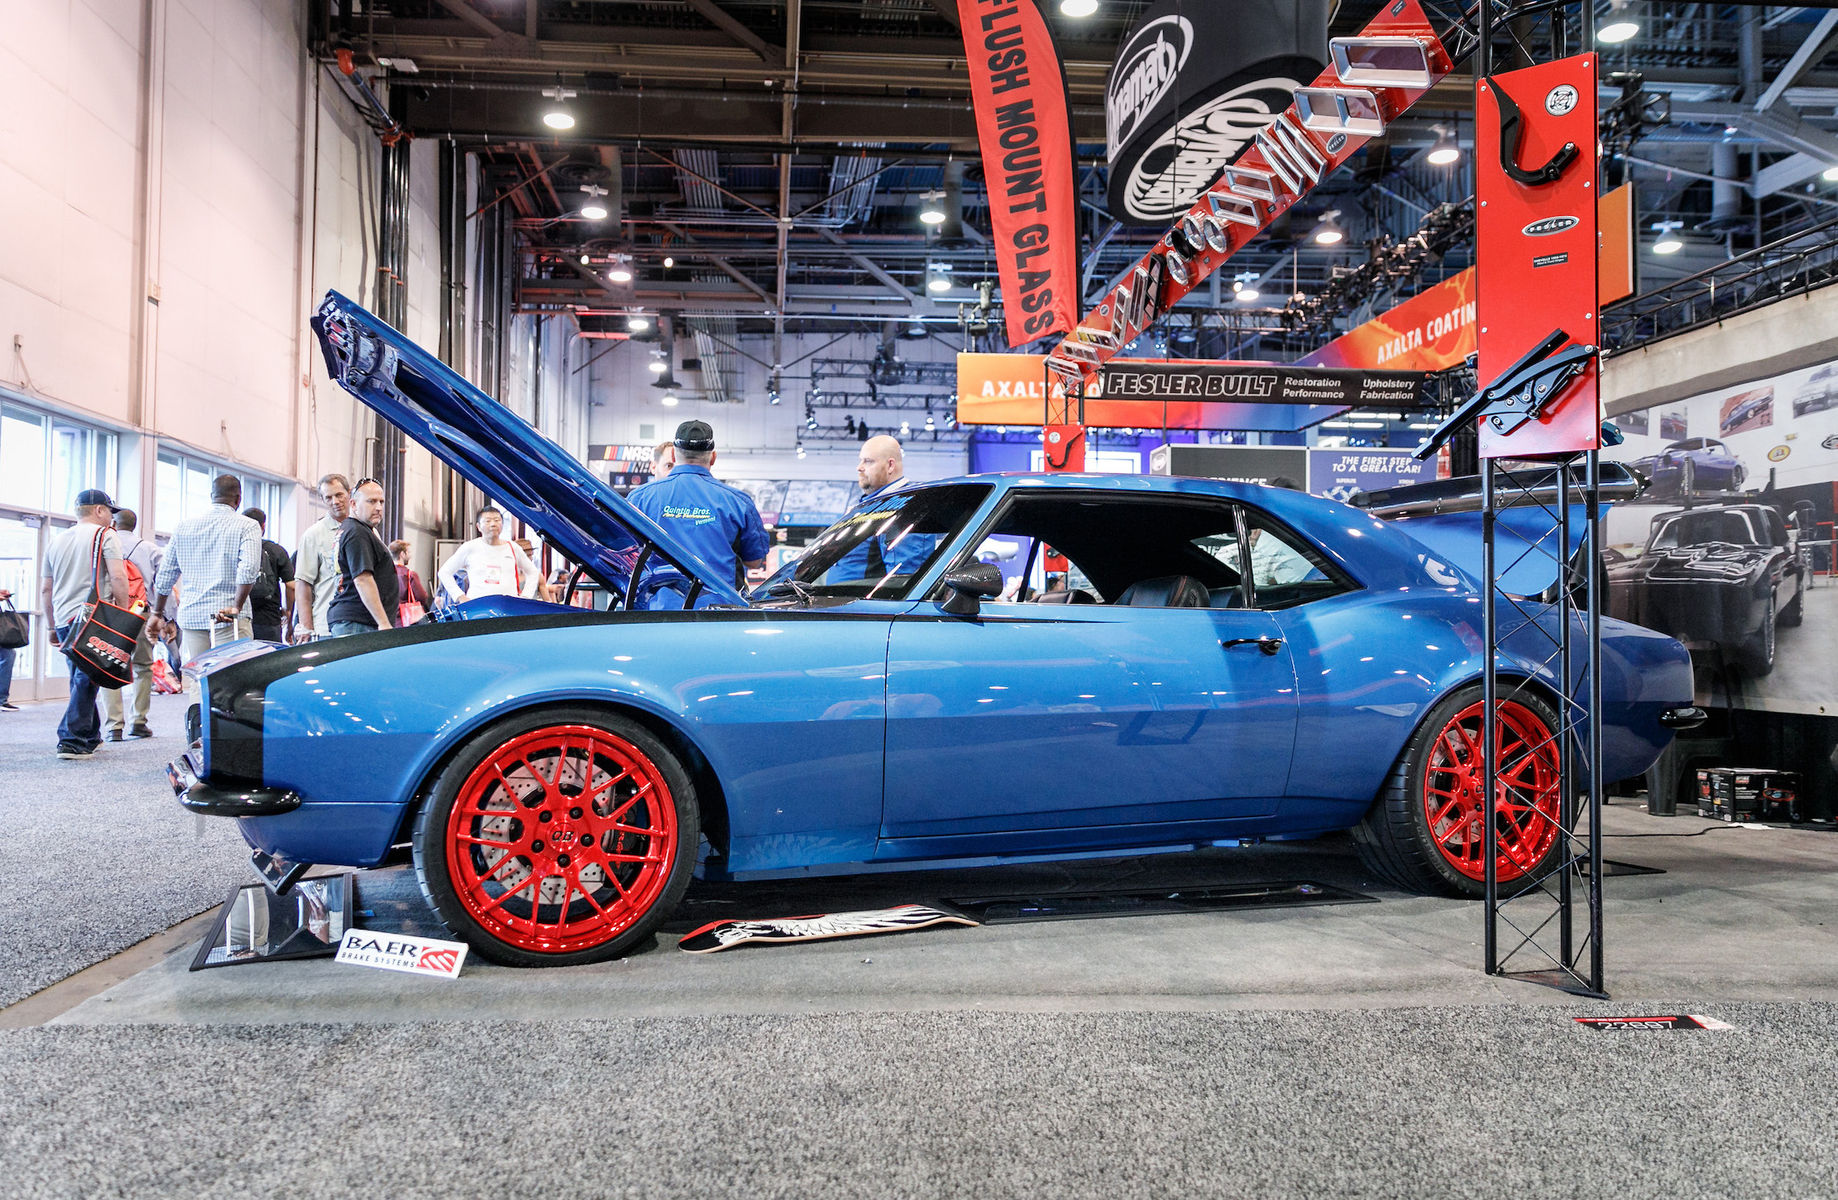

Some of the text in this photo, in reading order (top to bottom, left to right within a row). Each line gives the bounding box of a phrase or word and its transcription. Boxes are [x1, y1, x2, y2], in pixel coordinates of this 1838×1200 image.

[995, 99, 1048, 213] MOUNT
[1012, 223, 1055, 336] GLASS
[1377, 327, 1423, 365] AXALTA
[1108, 372, 1202, 396] FESLER
[1205, 375, 1277, 397] BUILT
[1284, 377, 1341, 388] Restoration
[1362, 379, 1415, 391] Upholstery
[1282, 388, 1345, 400] Performance
[1359, 391, 1414, 400] Fabrication
[1341, 456, 1413, 466] THE FIRST STEP
[1332, 464, 1422, 474] TO A GREAT CAR!
[346, 937, 418, 957] BAER
[341, 951, 416, 968] BRAKE SYSTEMS
